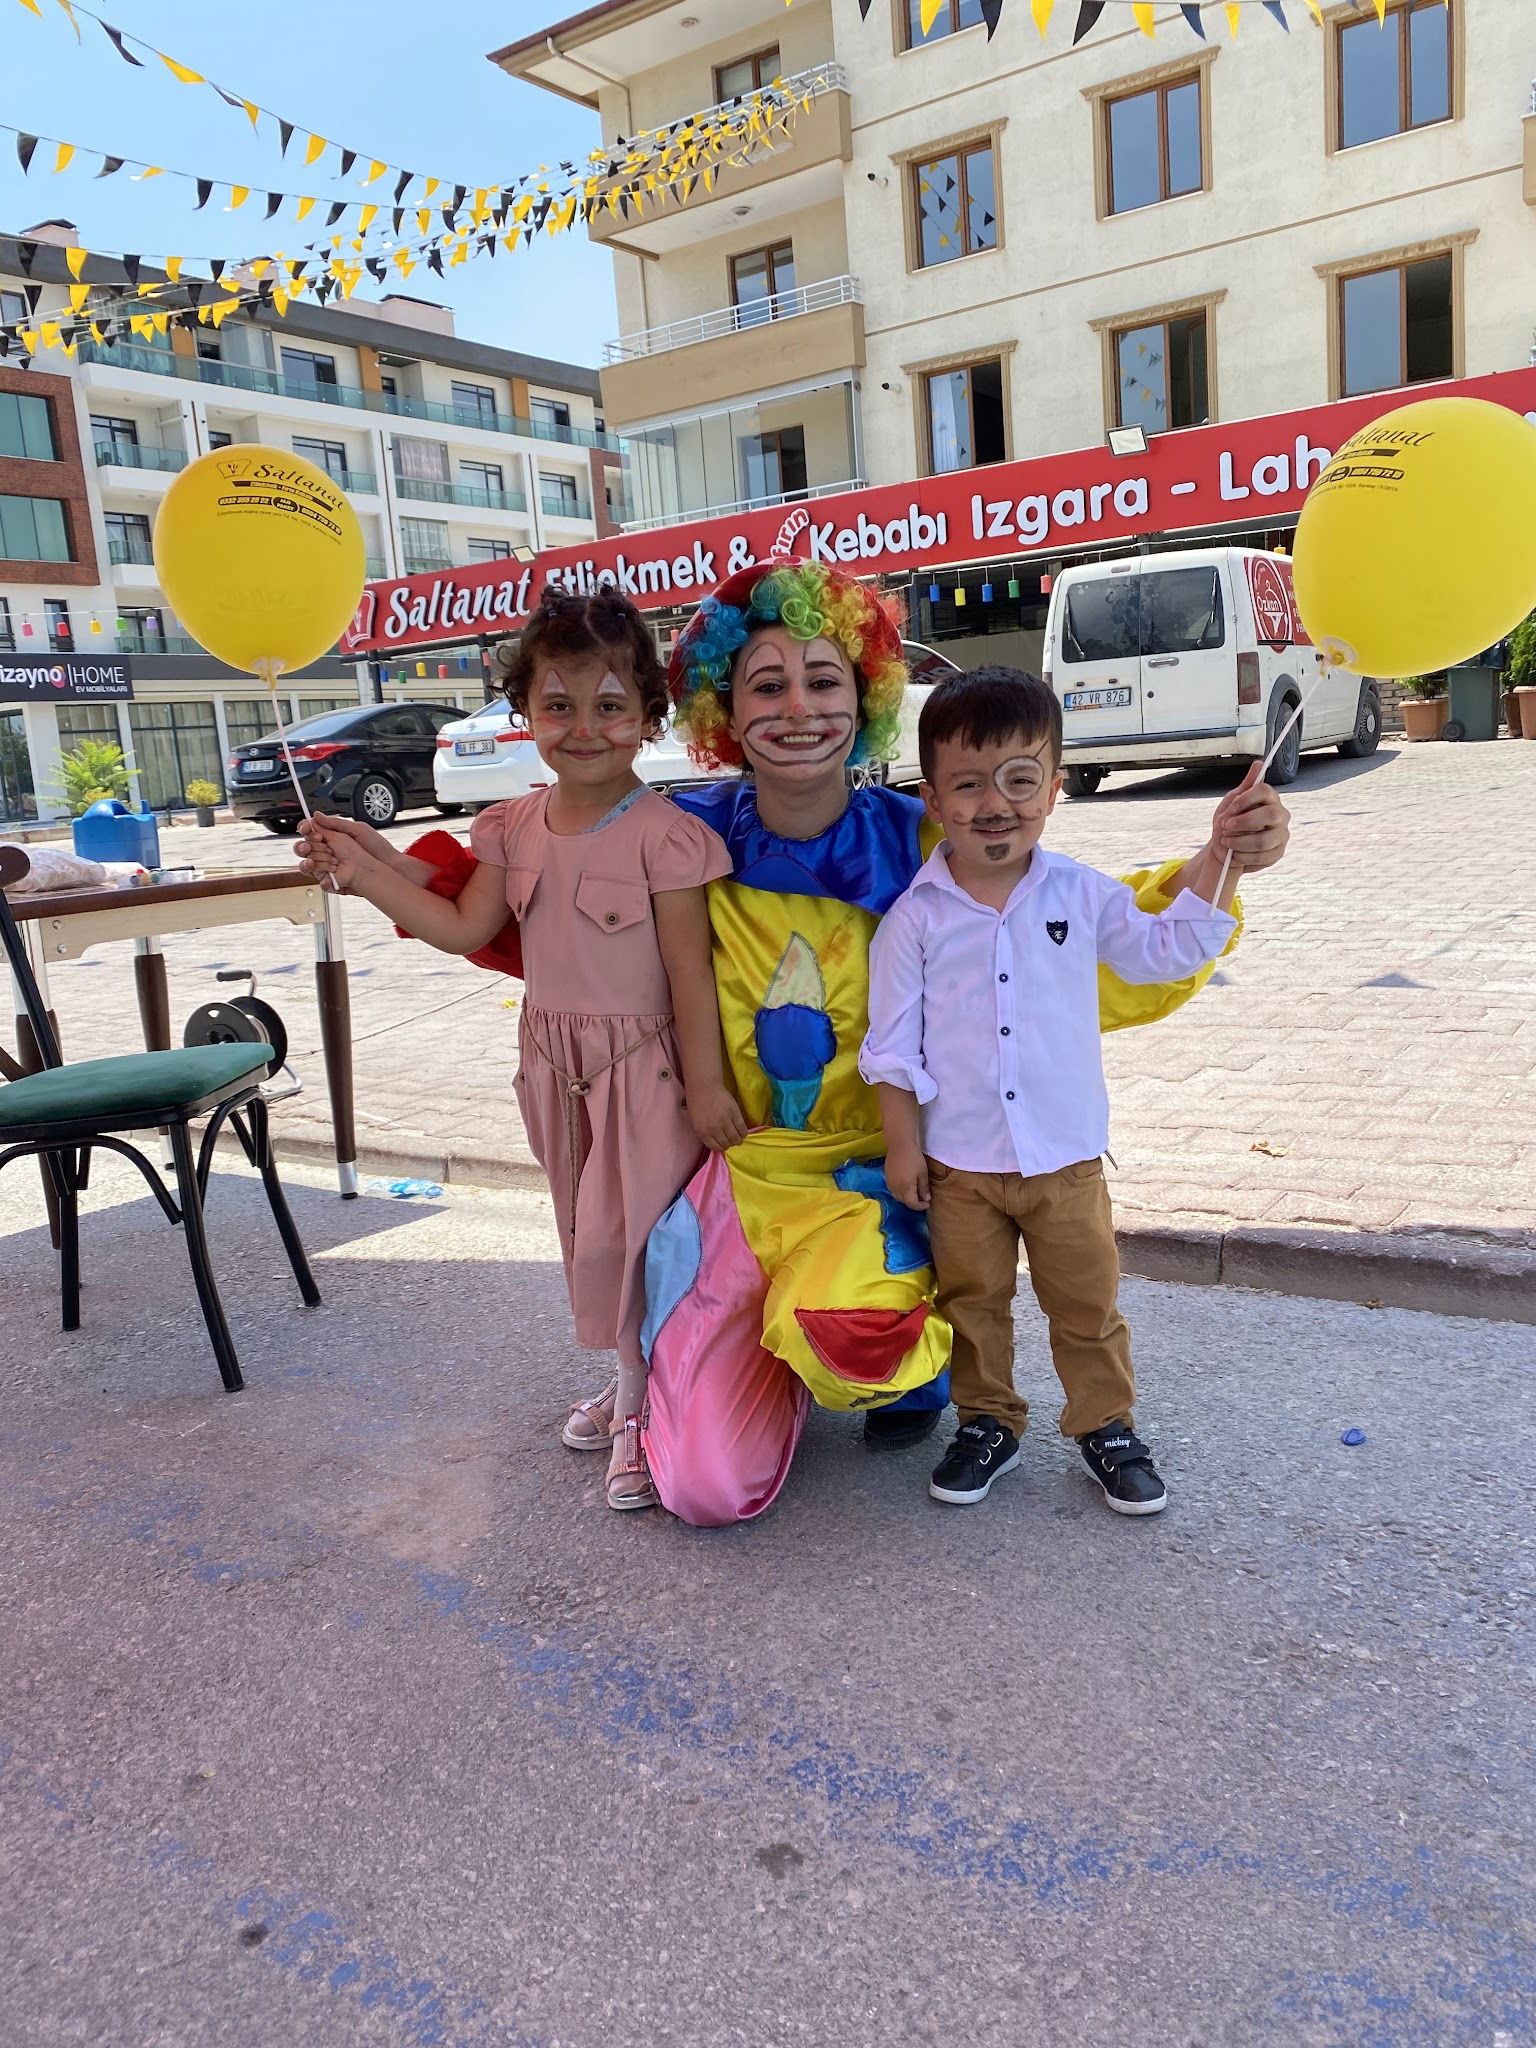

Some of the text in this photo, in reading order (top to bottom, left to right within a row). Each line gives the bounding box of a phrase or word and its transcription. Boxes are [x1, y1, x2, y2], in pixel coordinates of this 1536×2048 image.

[253, 463, 344, 511] Saltanat
[384, 568, 531, 638] Saltanat
[727, 535, 755, 577] &
[809, 503, 947, 563] Kebabı
[971, 478, 1149, 545] Izgara
[1219, 435, 1332, 501] Lah
[0, 665, 126, 689] izayno HOME
[1072, 690, 1125, 705] 42 VR 876
[1104, 1436, 1131, 1448] mickey
